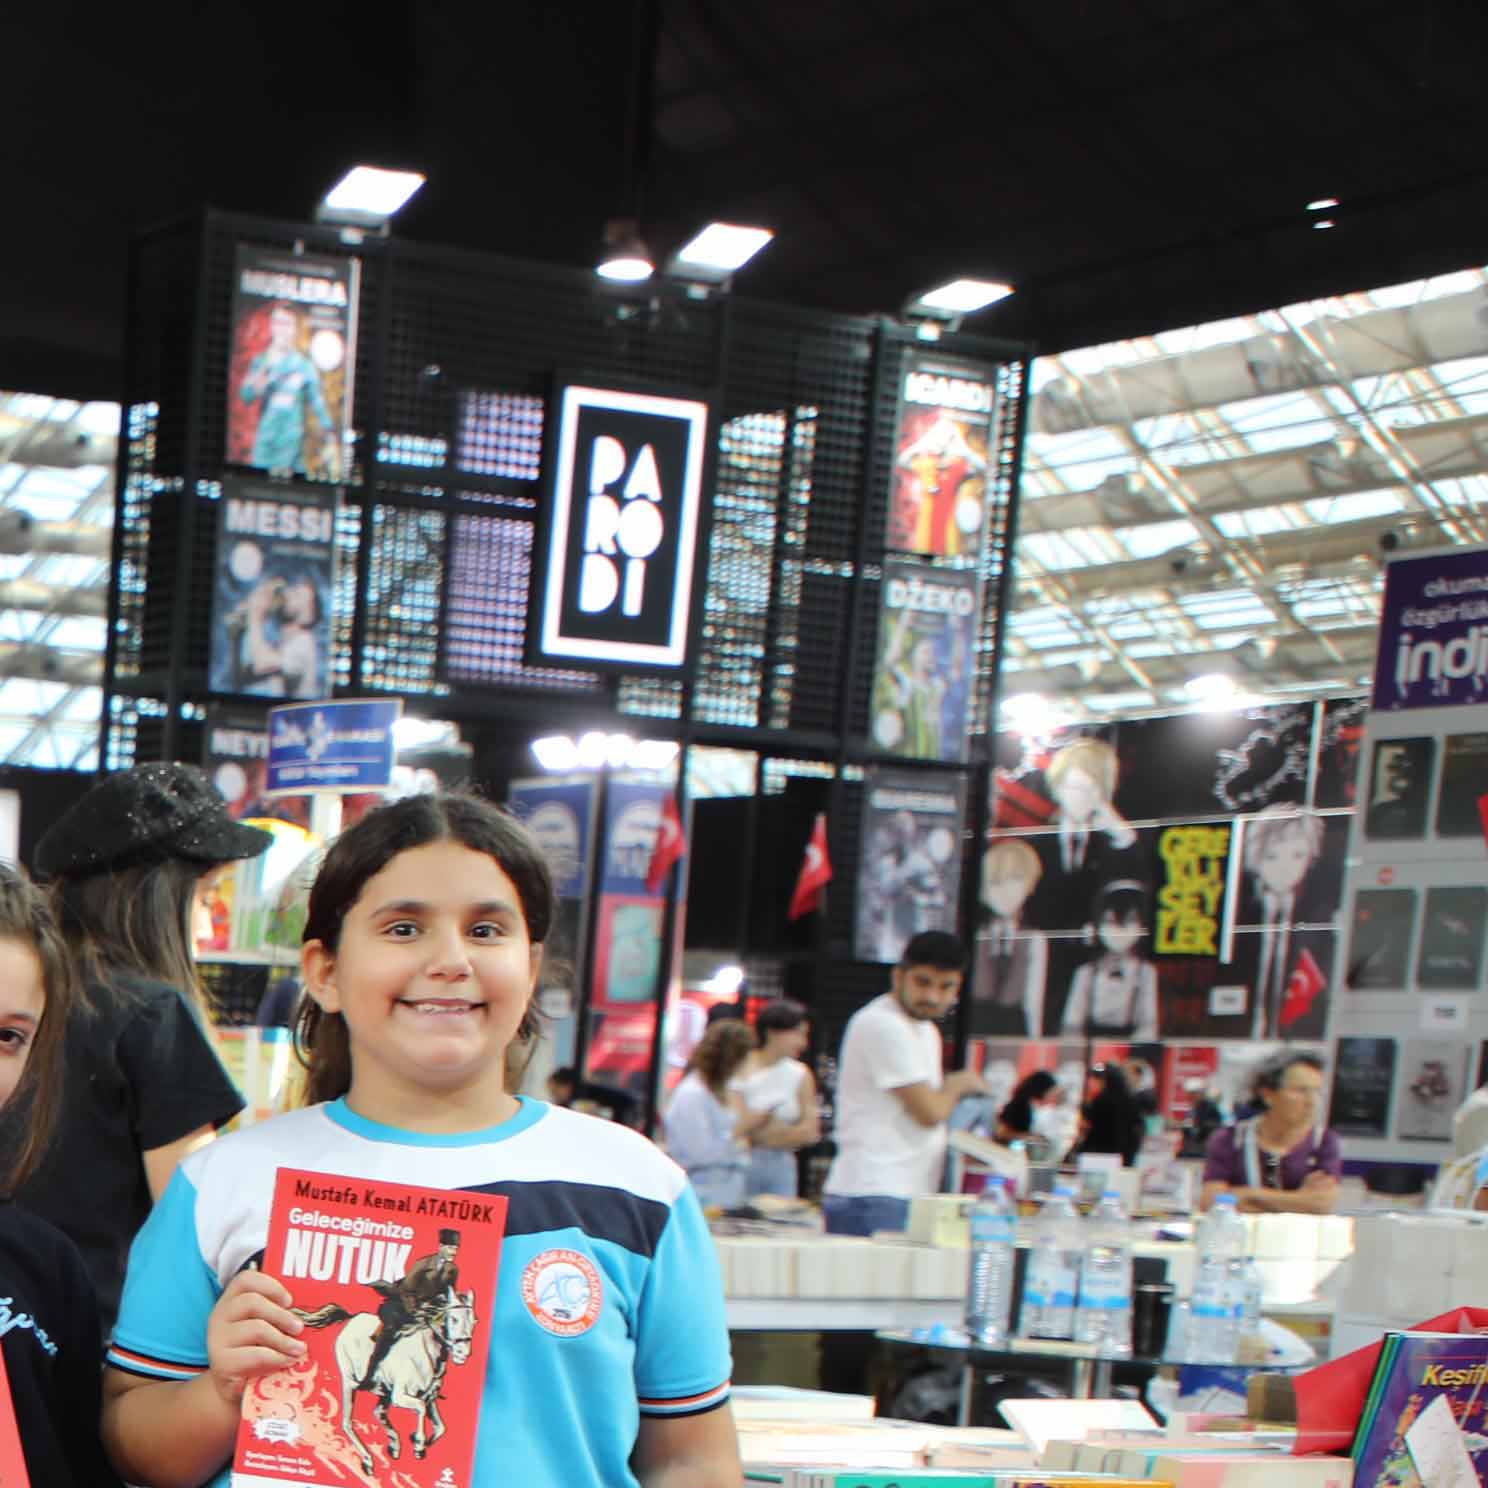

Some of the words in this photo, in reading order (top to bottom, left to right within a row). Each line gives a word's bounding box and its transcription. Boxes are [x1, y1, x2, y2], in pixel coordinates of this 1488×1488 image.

[225, 500, 332, 543] MESSI
[295, 1179, 358, 1206] Mustafa
[364, 1189, 412, 1214] Kemal
[416, 1197, 495, 1224] ATATÜRK
[289, 1208, 415, 1240] Geleceğimize
[282, 1229, 412, 1285] NUTUK
